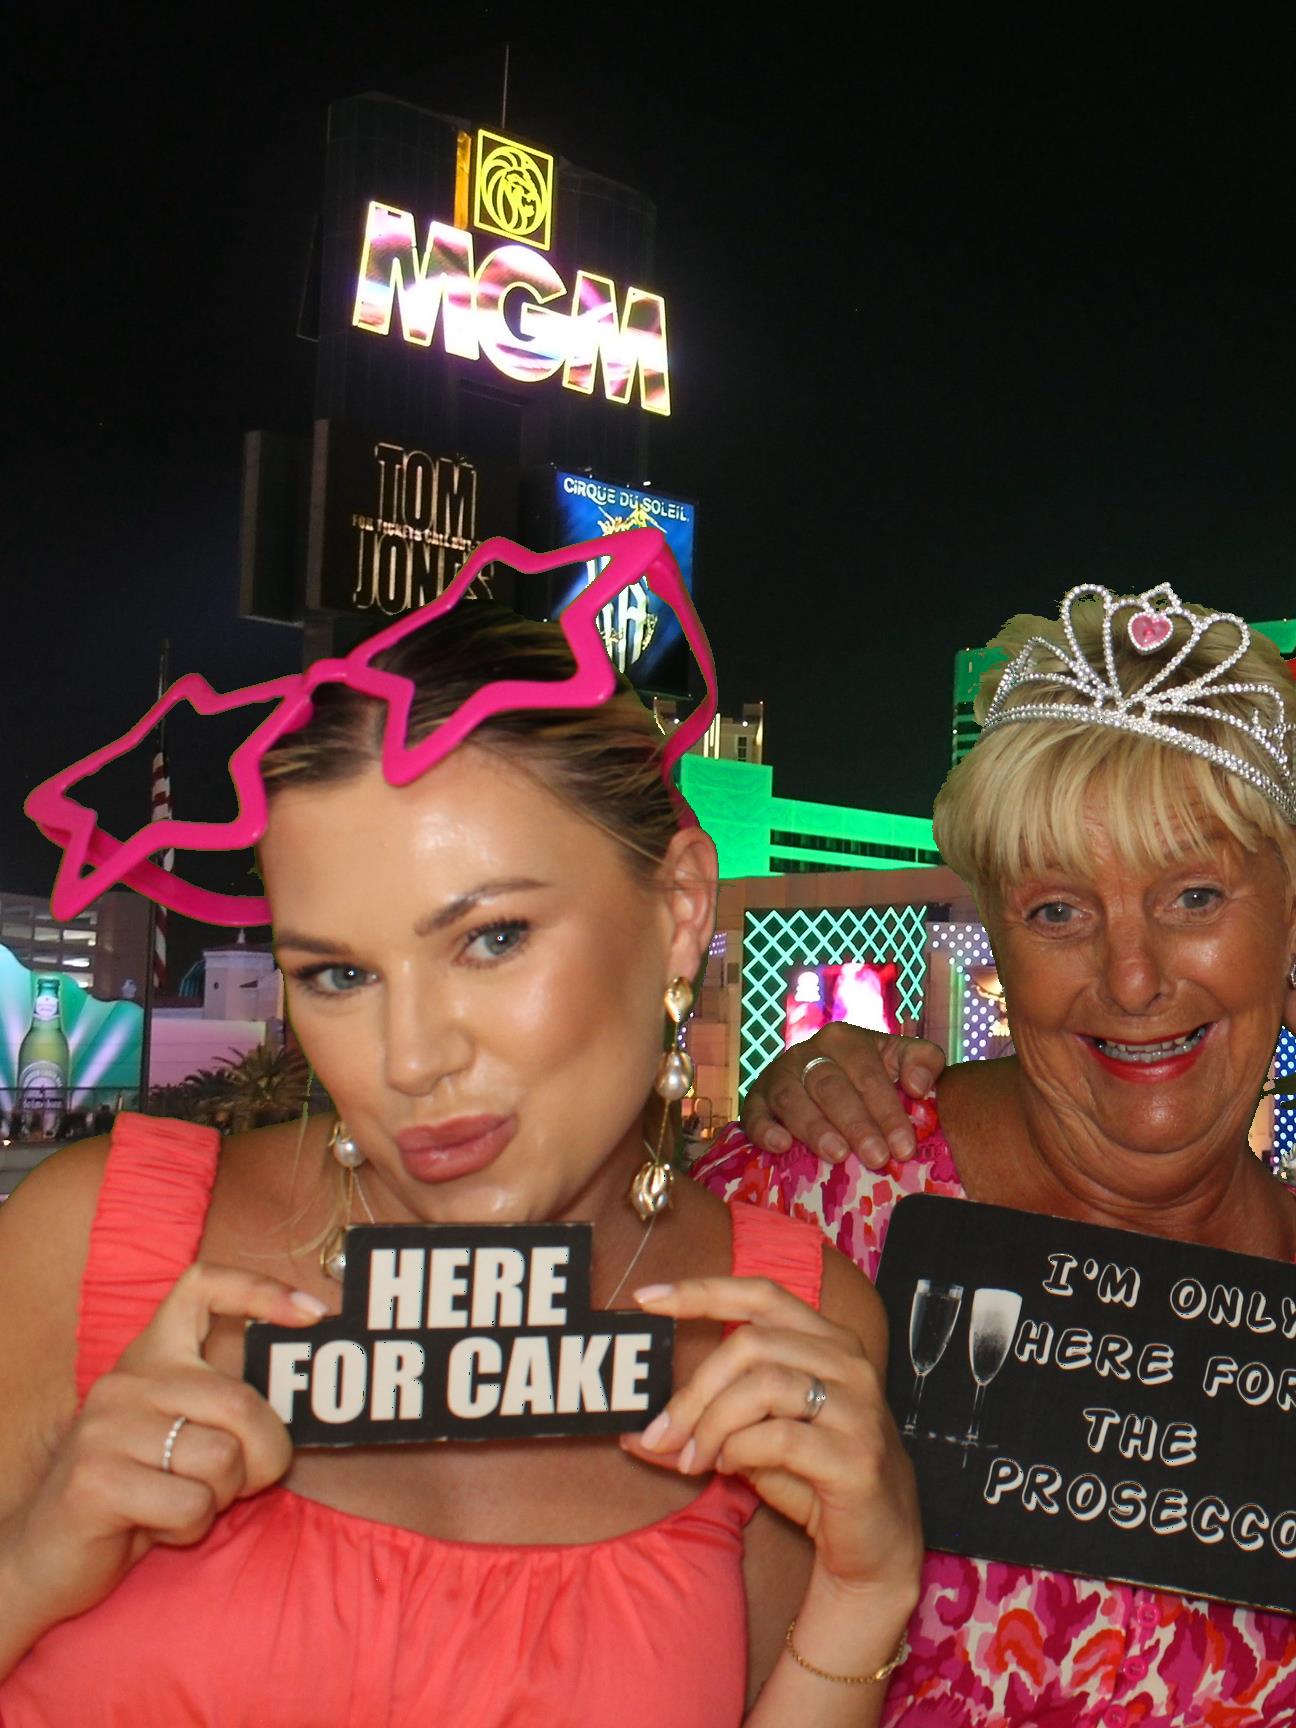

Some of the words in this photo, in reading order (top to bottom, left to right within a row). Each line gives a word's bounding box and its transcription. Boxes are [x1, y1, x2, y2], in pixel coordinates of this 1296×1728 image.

[353, 200, 671, 416] MGM
[374, 442, 477, 539] TOM
[563, 477, 616, 505] CIRQUE
[619, 491, 639, 509] DU
[642, 497, 687, 521] SOLEIL
[367, 1246, 570, 1330] HERE
[1042, 1253, 1140, 1307] I'M
[268, 1339, 425, 1424] FOR
[447, 1333, 652, 1419] CAKE
[1014, 1320, 1174, 1385] HERE
[1083, 1408, 1197, 1465] THE
